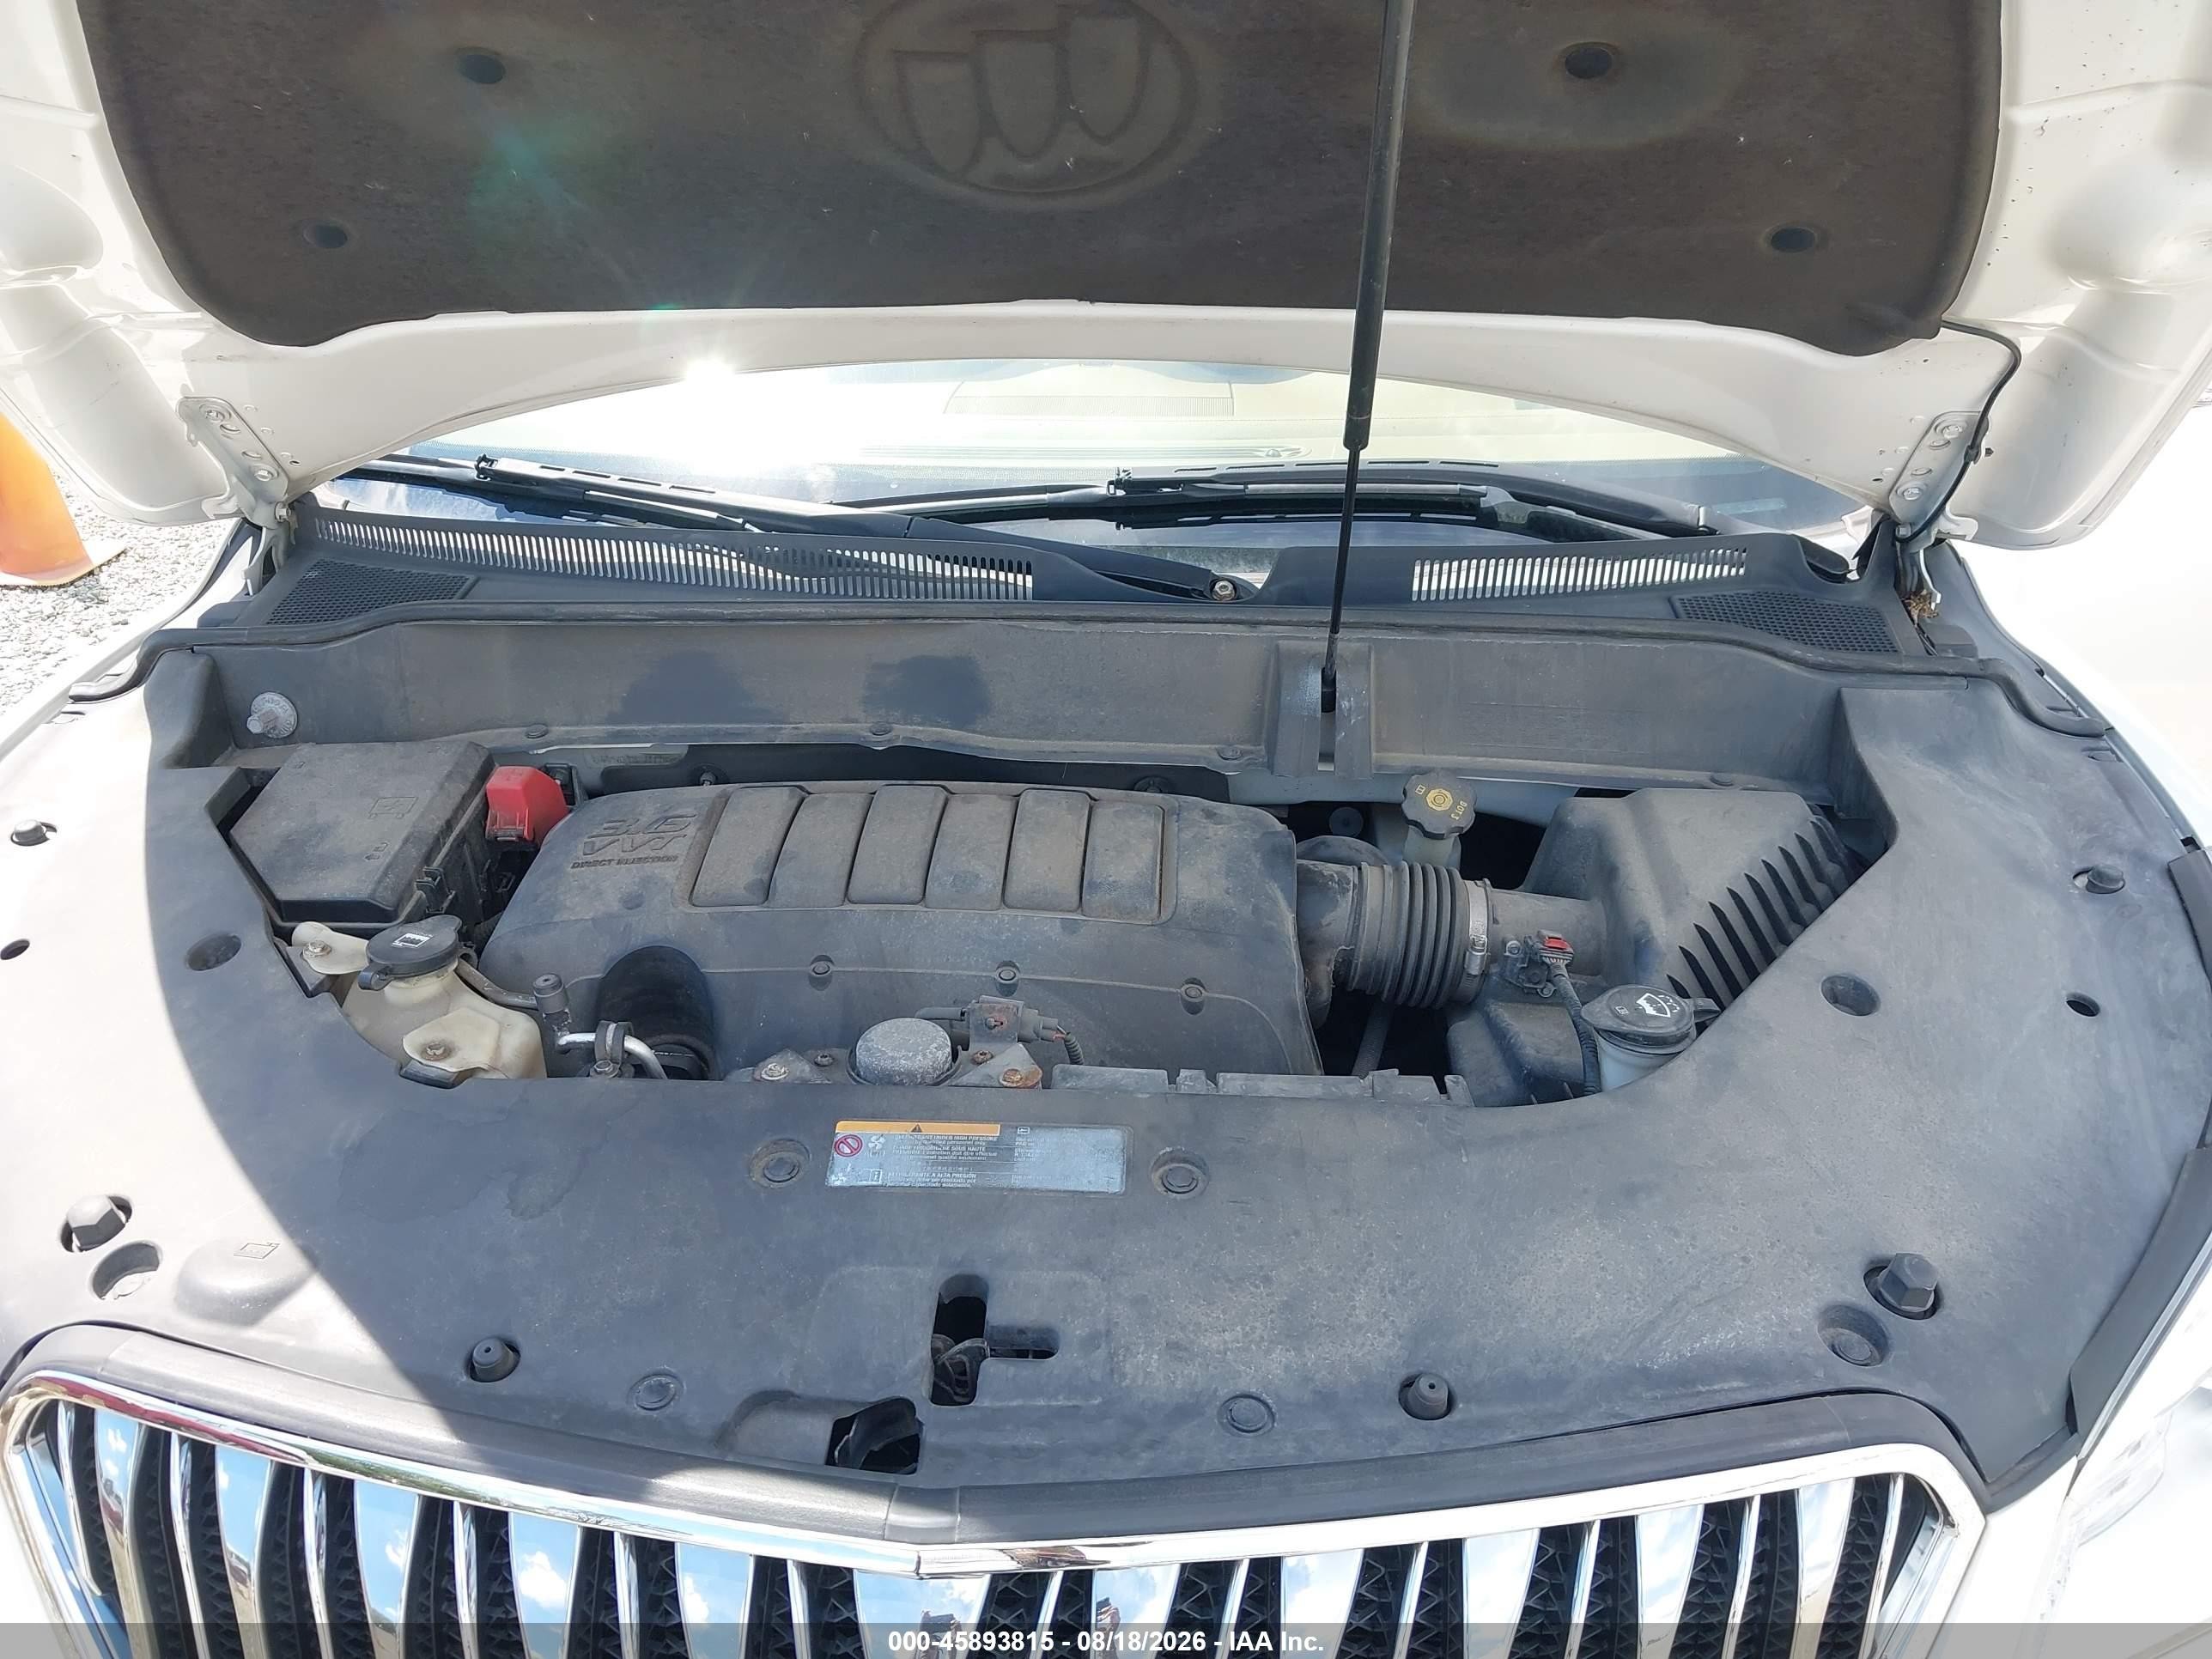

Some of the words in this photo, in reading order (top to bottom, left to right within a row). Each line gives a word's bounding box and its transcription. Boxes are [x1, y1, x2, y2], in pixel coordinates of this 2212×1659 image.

[587, 814, 696, 839] 3.6
[583, 834, 687, 856] VVT
[570, 859, 614, 869] DIRECT
[616, 855, 679, 866] INJECTION
